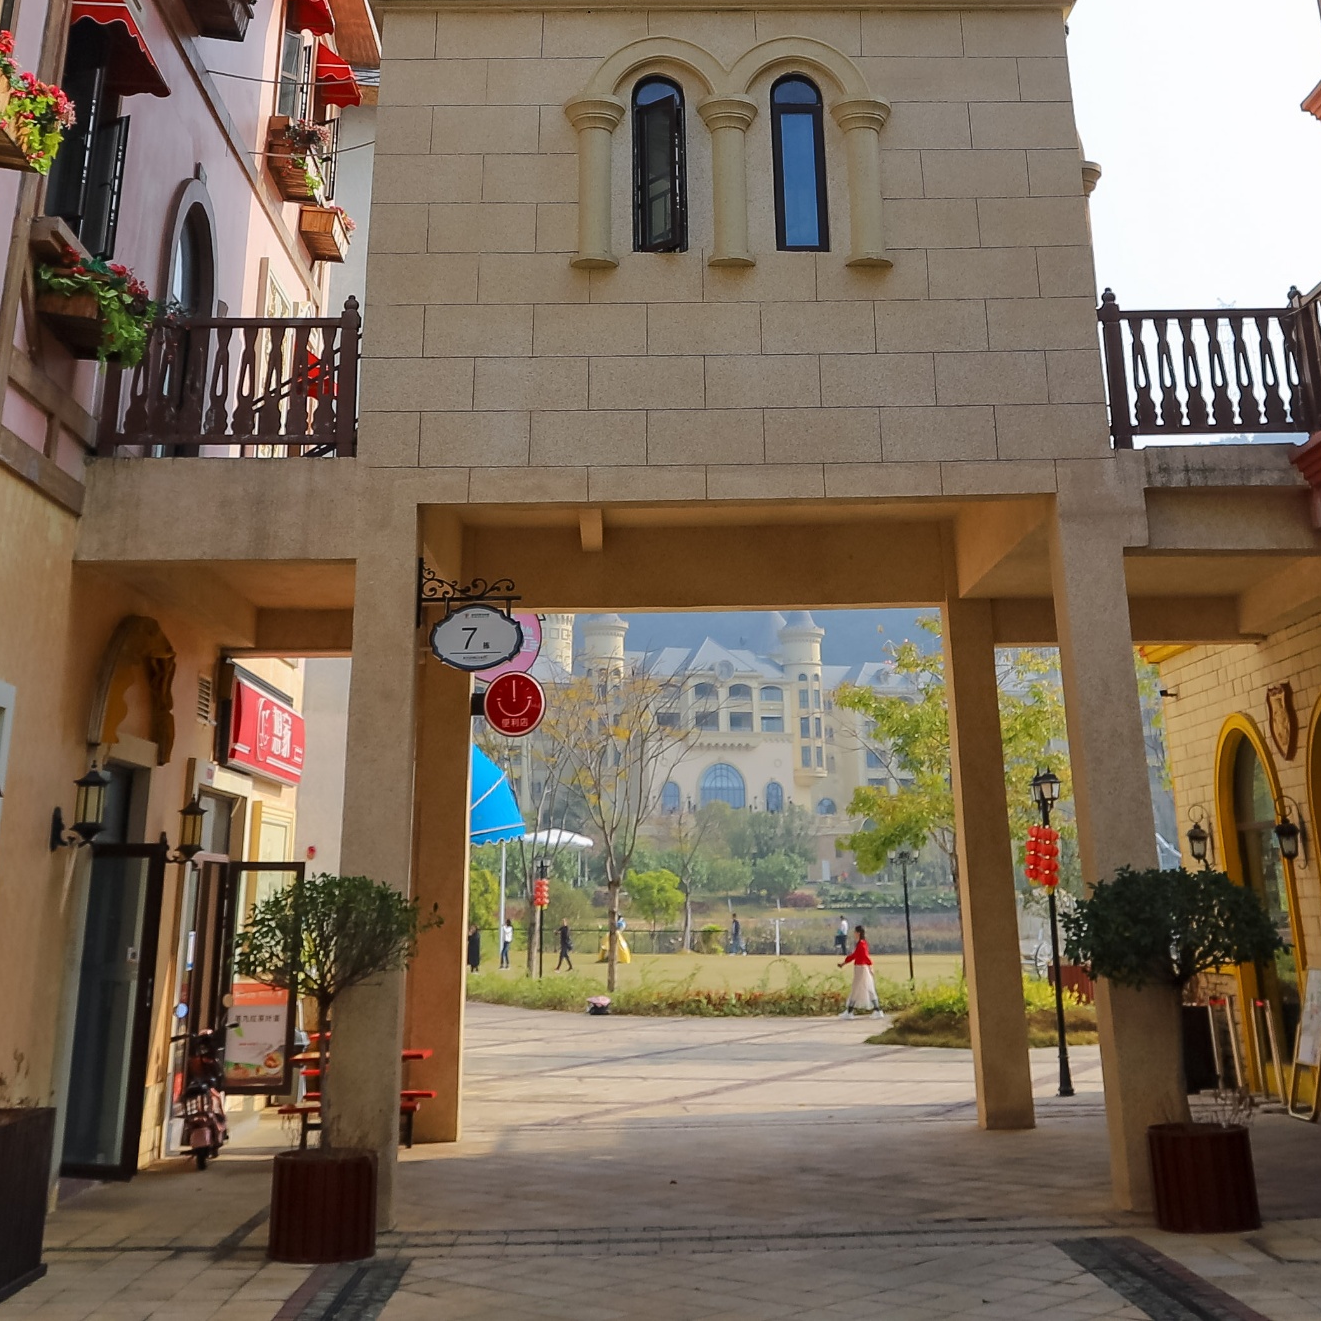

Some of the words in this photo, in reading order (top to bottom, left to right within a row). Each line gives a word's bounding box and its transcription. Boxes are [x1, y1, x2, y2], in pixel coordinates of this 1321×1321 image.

[461, 627, 478, 650] 7
[501, 718, 529, 728] 便利店
